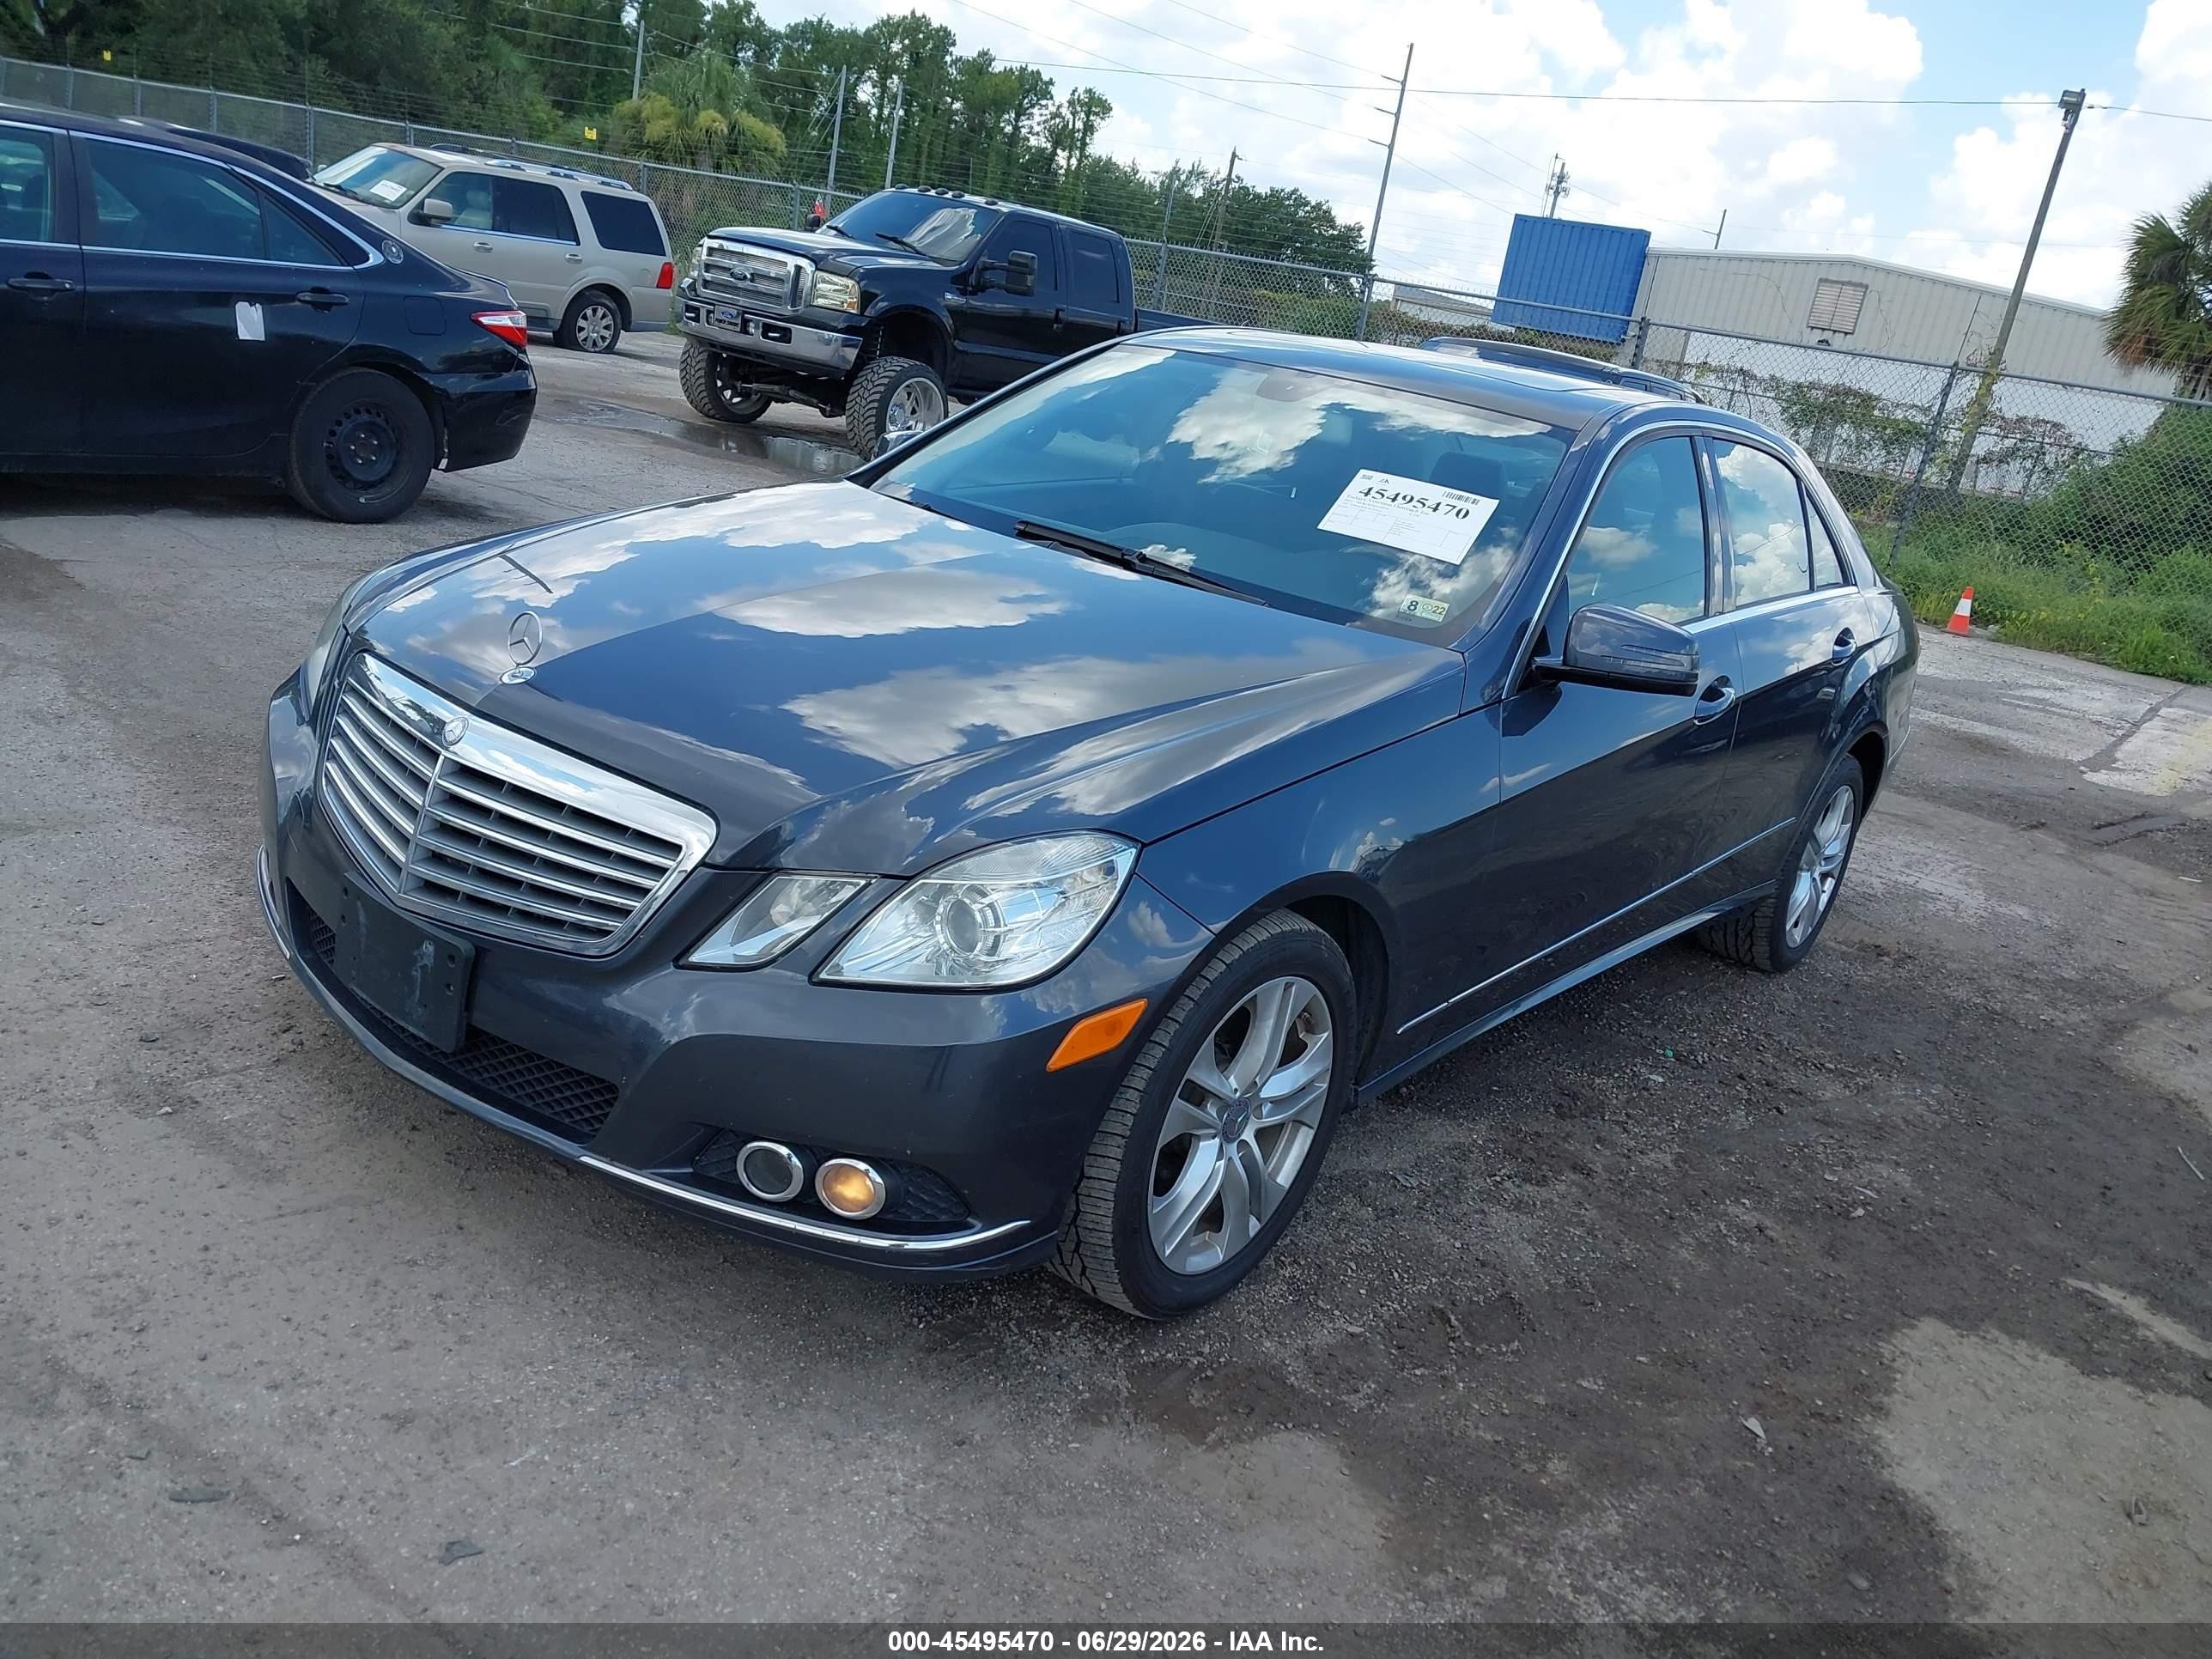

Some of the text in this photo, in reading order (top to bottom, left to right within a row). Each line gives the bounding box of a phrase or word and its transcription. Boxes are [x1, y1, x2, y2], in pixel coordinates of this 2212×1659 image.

[1359, 487, 1469, 520] 45495470
[1407, 600, 1446, 616] 8 22
